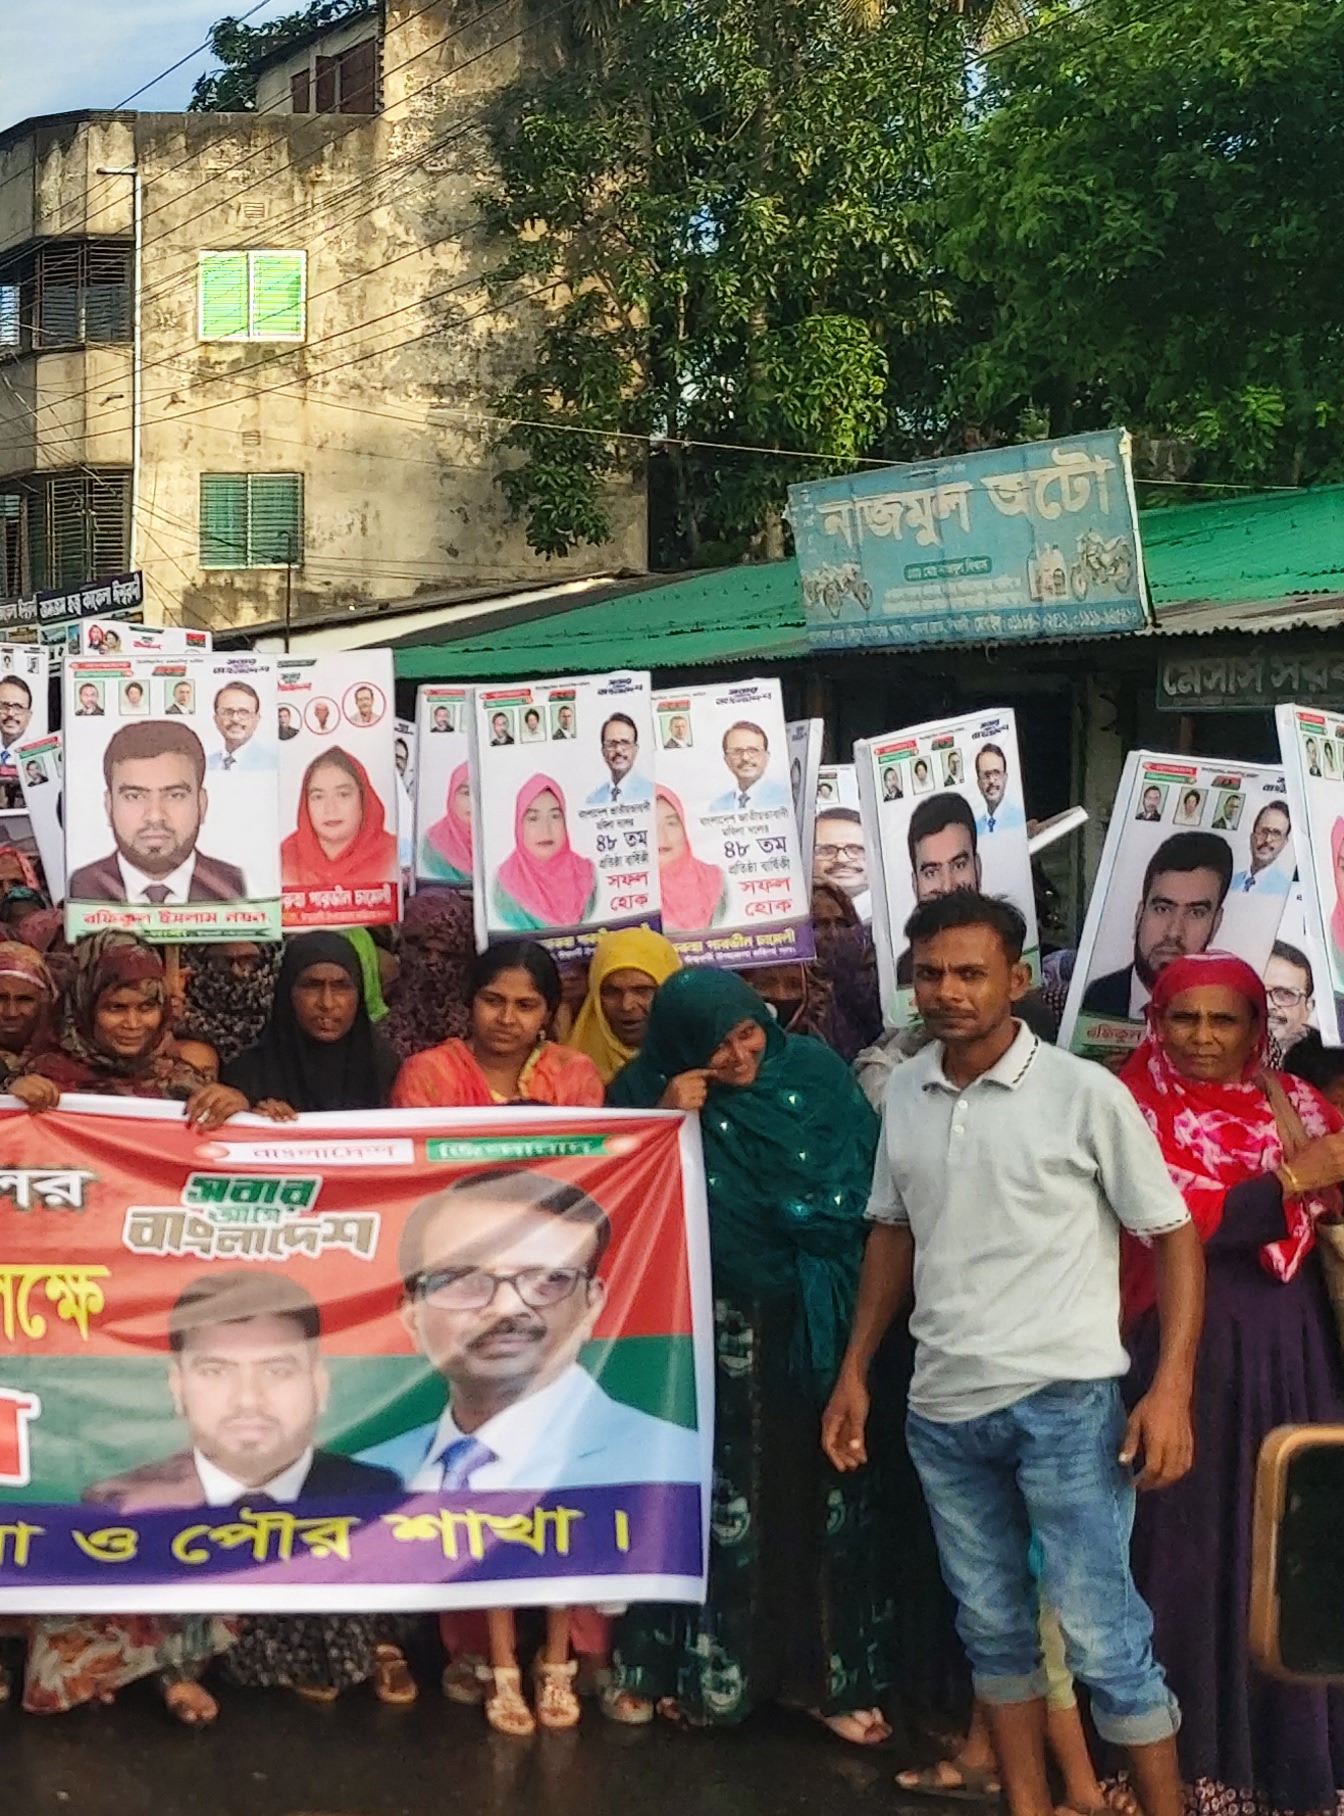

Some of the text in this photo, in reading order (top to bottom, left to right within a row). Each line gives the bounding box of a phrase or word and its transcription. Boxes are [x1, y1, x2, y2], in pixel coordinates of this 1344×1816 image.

[817, 448, 1116, 548] নাজমুল অটো
[596, 830, 648, 852] ৪৮ তম
[724, 835, 787, 858] ৪৮ তম
[606, 872, 649, 888] সফল
[740, 877, 791, 895] সফল
[610, 893, 649, 911] হোক
[745, 899, 792, 918] হোক
[188, 1176, 318, 1210] সবার
[126, 1208, 378, 1259] বাংলাদেশ
[72, 1528, 138, 1562] ও
[172, 1508, 361, 1566] পৌর
[387, 1505, 586, 1564] শাখা
